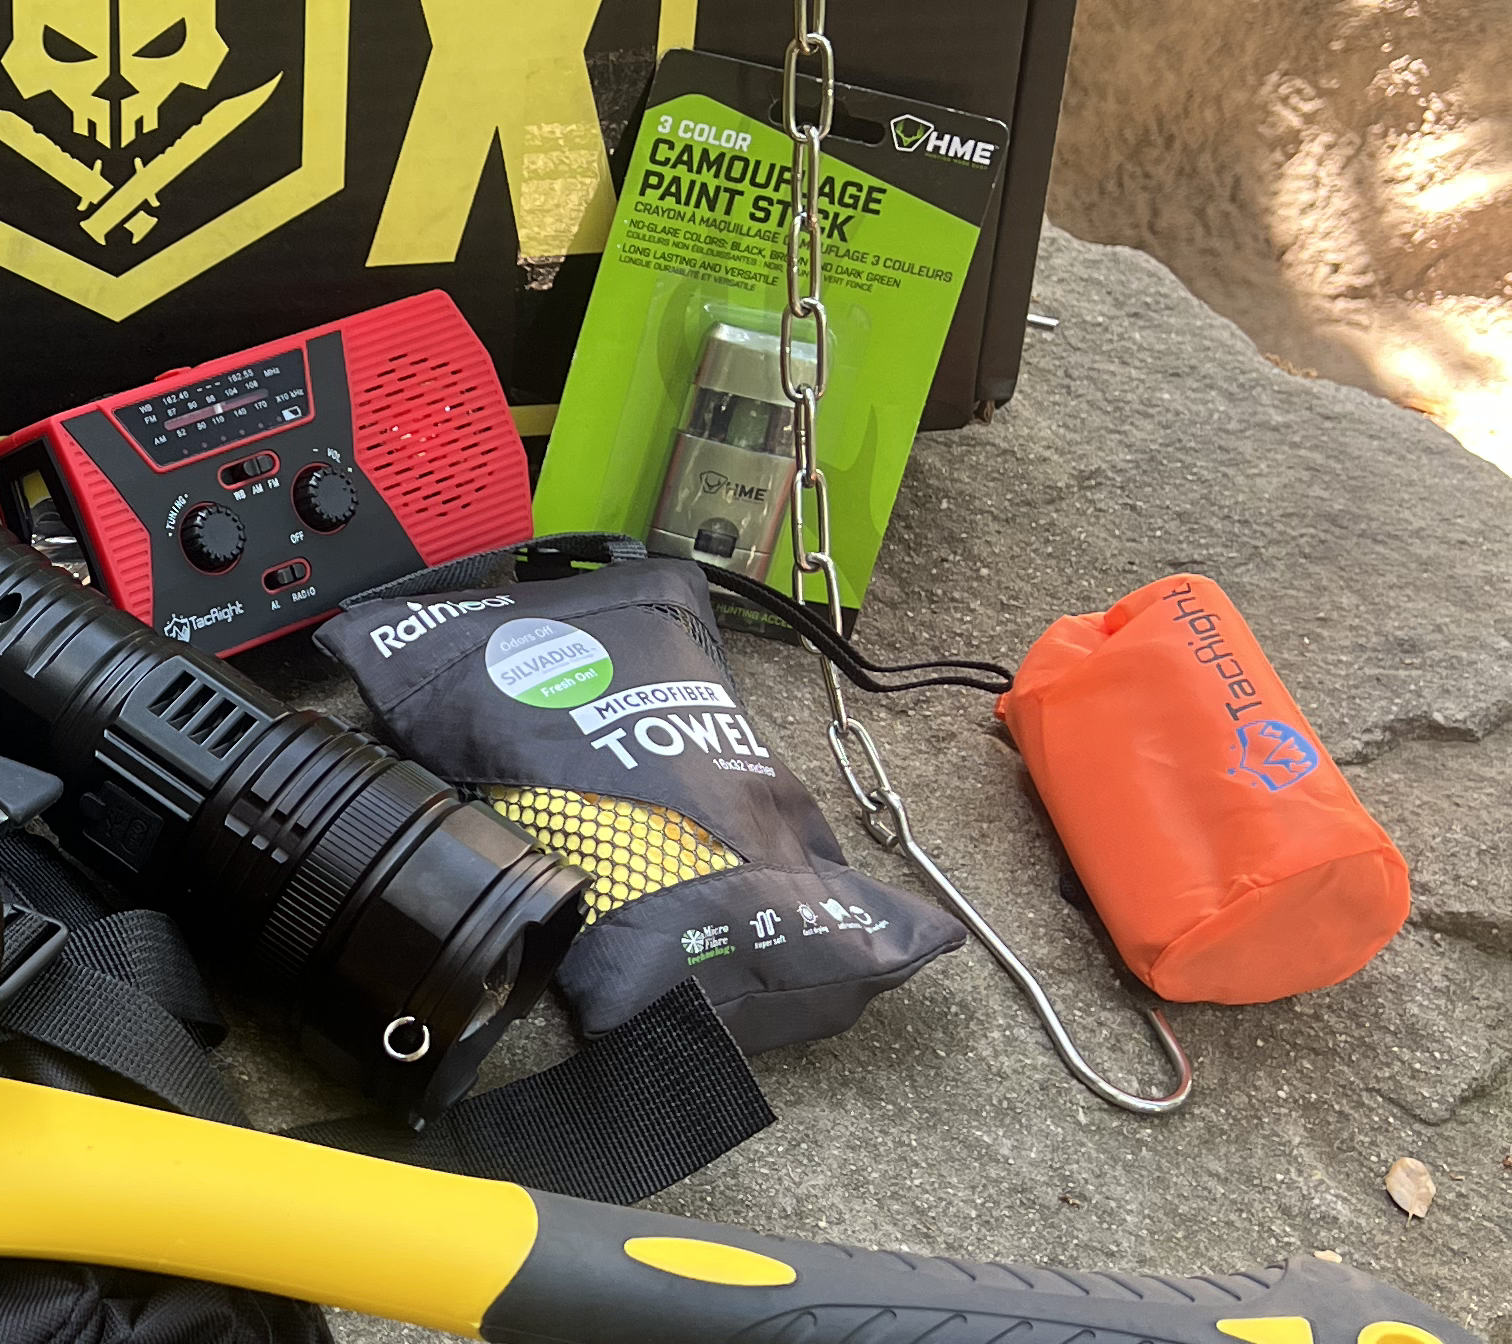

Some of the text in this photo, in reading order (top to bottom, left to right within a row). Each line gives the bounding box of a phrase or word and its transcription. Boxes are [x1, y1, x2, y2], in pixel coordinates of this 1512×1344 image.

[657, 115, 752, 152] 3 COLOR
[925, 131, 995, 166] HME
[648, 137, 887, 216] CAMOUFAGE
[639, 169, 856, 243] PAINT STCK
[629, 218, 682, 239] NO-GLARE
[834, 264, 863, 280] DARK
[865, 272, 902, 289] GREEN
[633, 201, 687, 223] CRAYON
[698, 215, 781, 244] MAQUILLAGE
[782, 233, 868, 265] CMUFLAGE
[871, 255, 881, 267] 3
[883, 257, 954, 284] COULEURS
[622, 242, 780, 286] LONG LASTING AND VERSATILE
[144, 414, 157, 425] FM
[153, 434, 168, 446] AM
[251, 482, 265, 496] AM
[266, 477, 281, 489] FM
[165, 497, 188, 531] TUNING
[289, 529, 305, 545] OFF
[291, 585, 317, 603] RADIO
[716, 603, 759, 621] HUNTING
[499, 632, 537, 653] Odors
[500, 641, 591, 686] SILVADUR
[539, 667, 599, 698] Fresh On!
[593, 685, 721, 721] MICROFIBER
[590, 712, 770, 770] TOWEL
